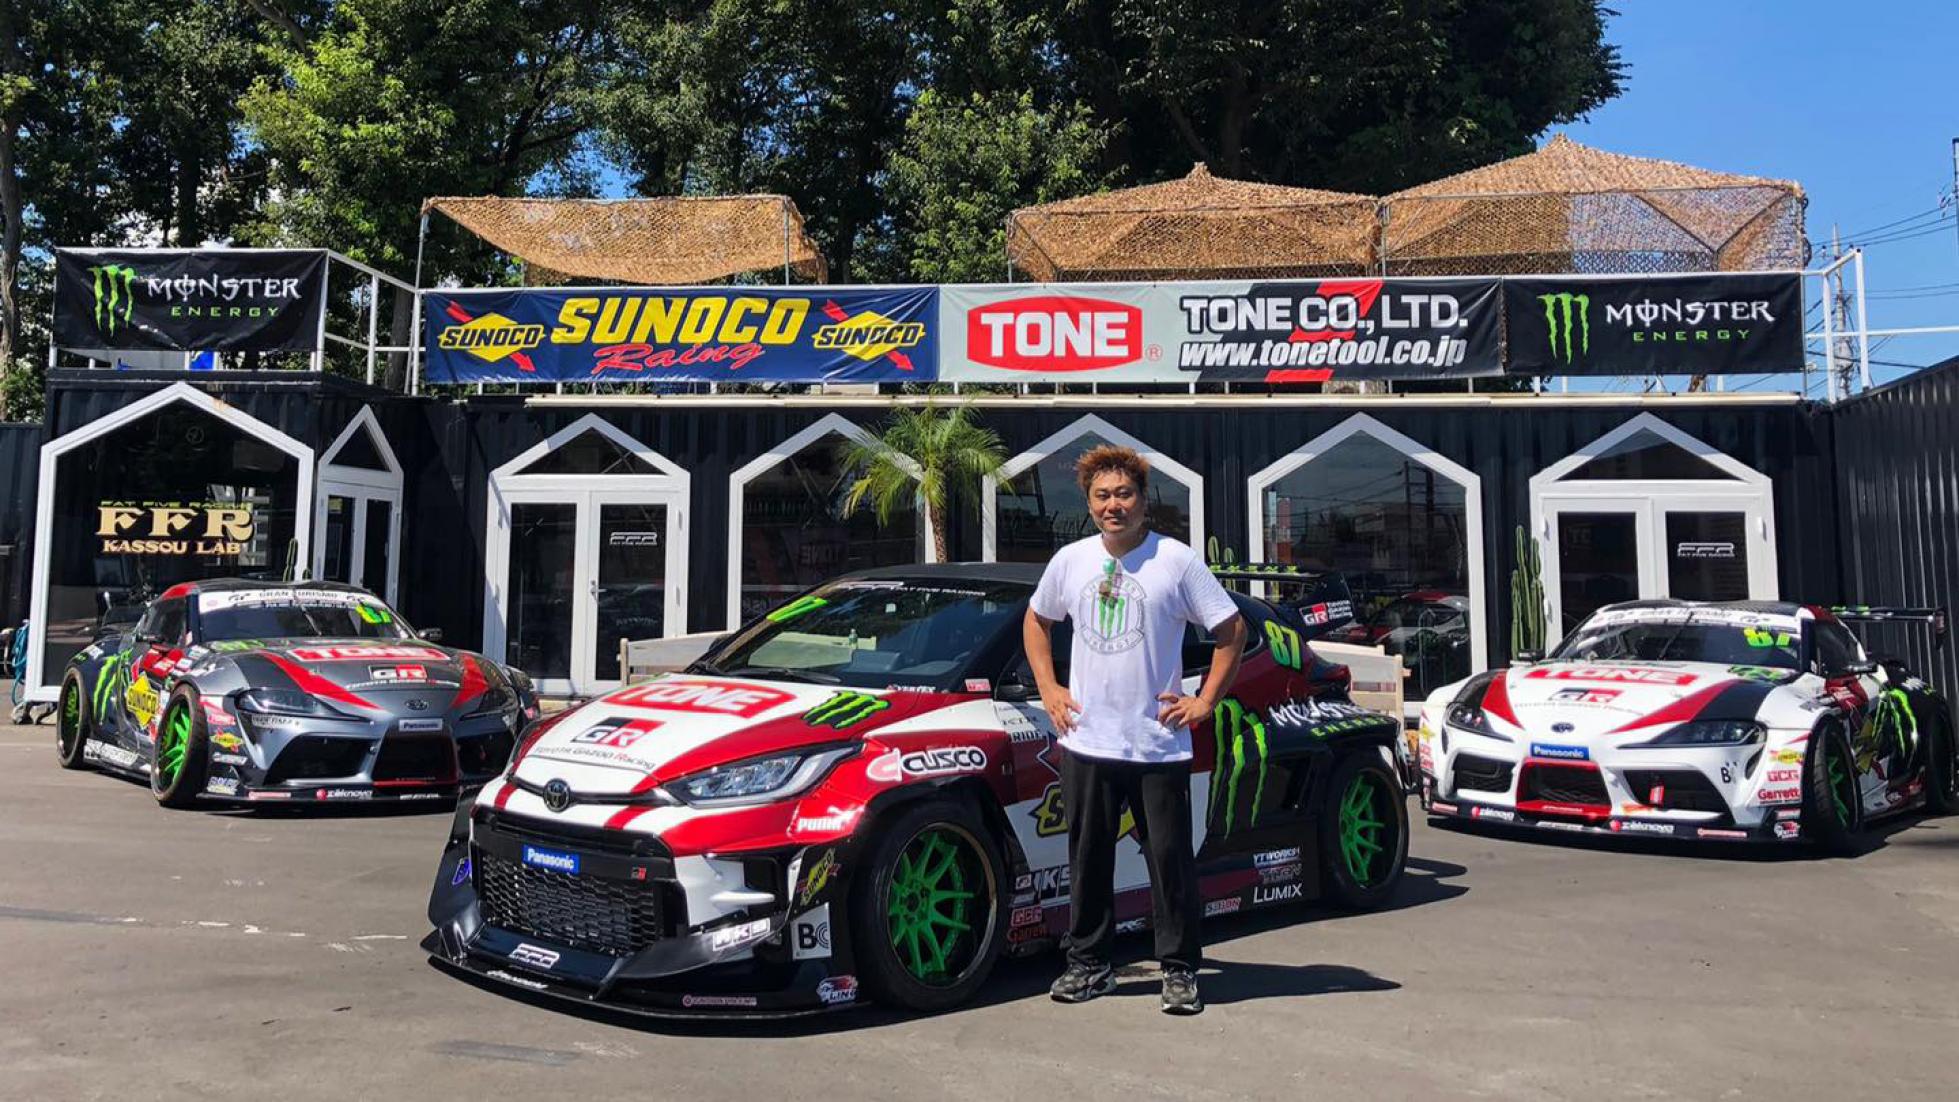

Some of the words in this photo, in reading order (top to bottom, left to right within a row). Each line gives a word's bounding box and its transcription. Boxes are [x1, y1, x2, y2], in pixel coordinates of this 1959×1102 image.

[147, 273, 301, 300] MONSTER
[172, 306, 280, 317] ENERGY
[551, 297, 811, 344] SUNOCO
[1182, 297, 1293, 331] TONE
[1381, 295, 1469, 328] LTD.
[1605, 298, 1775, 327] MONSTER
[442, 327, 541, 347] SUNOCO
[818, 324, 919, 346] SUNOCO
[981, 312, 1129, 357] TONE
[1633, 329, 1751, 342] ENERGY
[1180, 336, 1468, 367] www.tonetool.co.jp
[95, 506, 254, 541] FFR
[103, 539, 187, 554] KASSOU
[196, 540, 241, 555] LAB
[1264, 619, 1301, 670] 87
[618, 682, 782, 711] TONE
[582, 726, 644, 747] GR
[1534, 746, 1585, 758] Panasonic
[1758, 787, 1800, 800] Garrett
[527, 847, 575, 870] Panasonic
[1253, 883, 1303, 904] LUMIX
